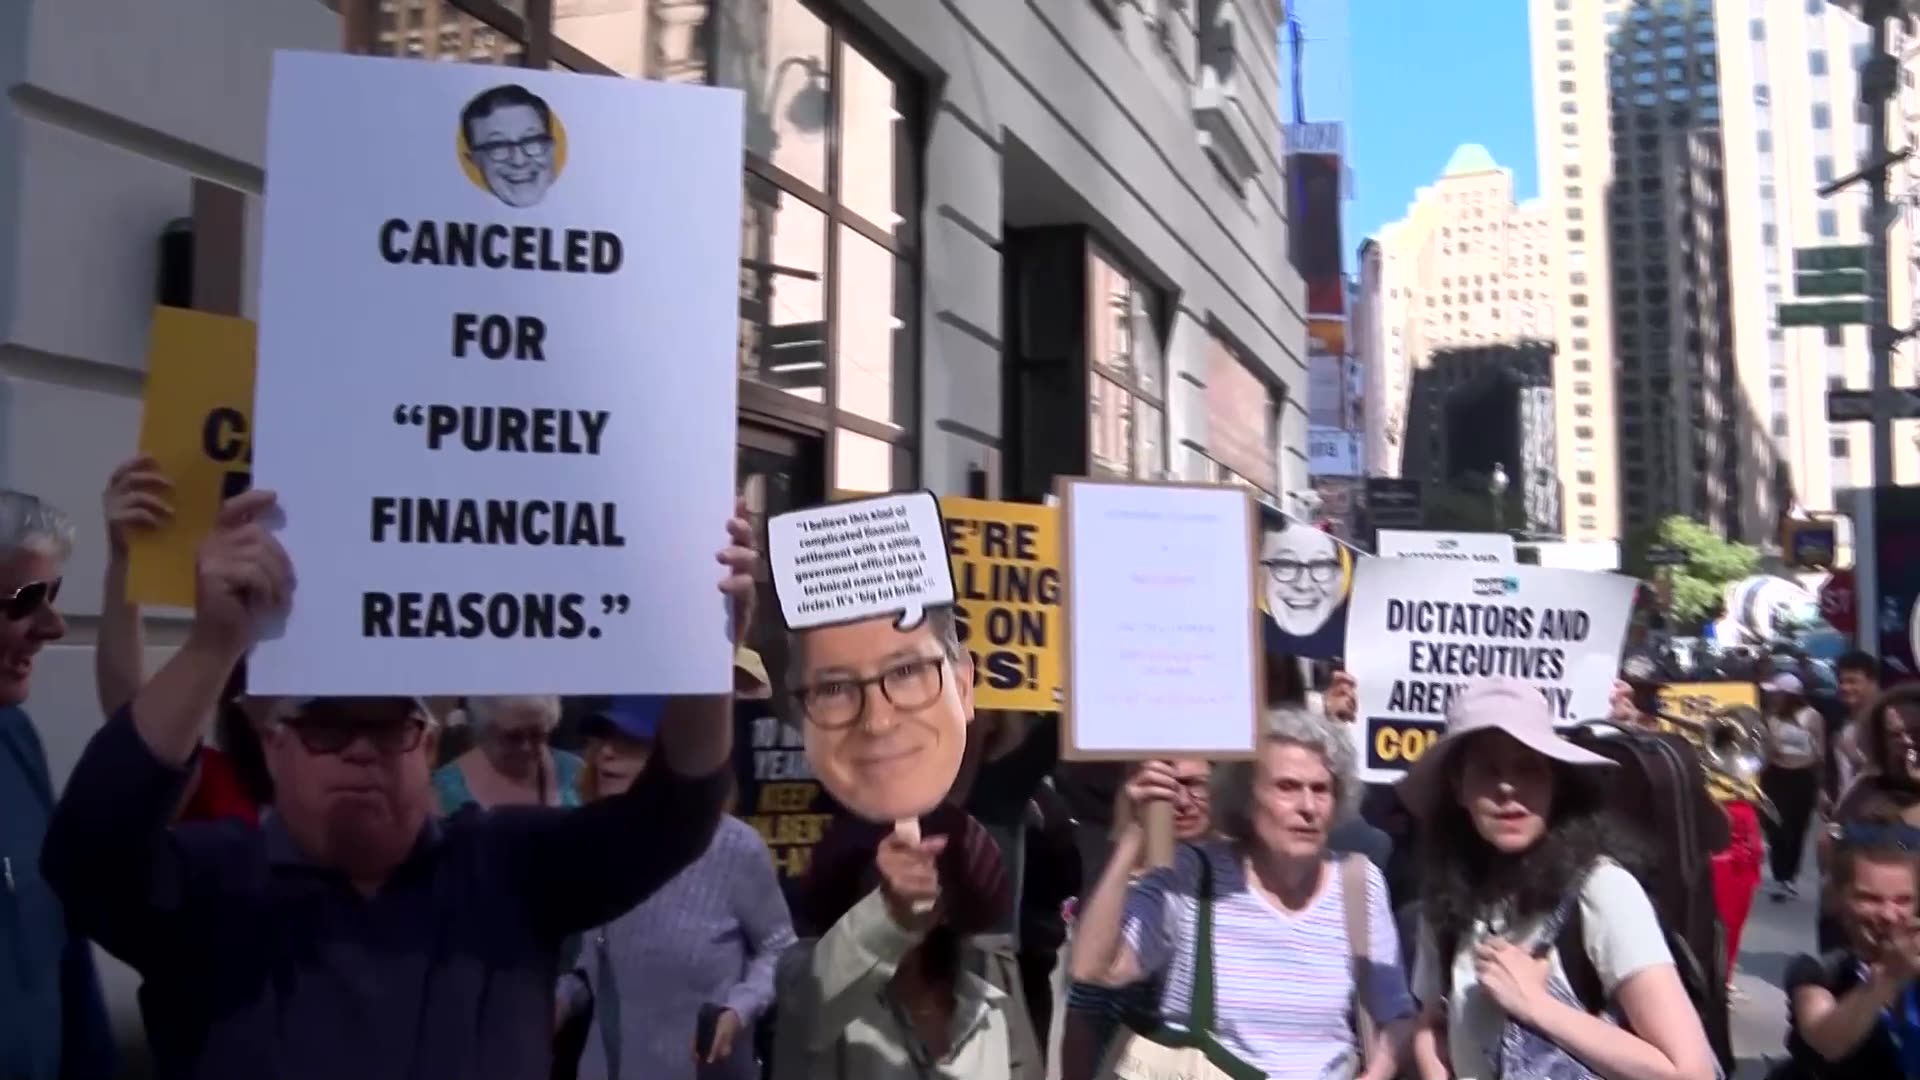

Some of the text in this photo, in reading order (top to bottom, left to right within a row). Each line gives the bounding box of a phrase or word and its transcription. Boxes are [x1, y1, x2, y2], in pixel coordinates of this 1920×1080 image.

[379, 218, 624, 274] CANCELED
[452, 312, 546, 361] FOR
[393, 405, 609, 454] “PURELY
[371, 497, 625, 546] FINANCIAL
[799, 519, 910, 548] complicated financial
[809, 517, 847, 531] believe
[848, 511, 869, 524] this
[870, 506, 894, 521] kind
[947, 517, 1039, 561] E'RE
[794, 535, 921, 565] settlement with a sitting
[794, 550, 927, 585] government official has a
[803, 564, 923, 597] technical name in legal
[877, 587, 893, 601] fat
[957, 563, 1061, 605] LING
[363, 593, 629, 639] REASONS.”
[985, 609, 1047, 648] ON
[1386, 598, 1590, 642] DICTATORS AND
[1409, 640, 1565, 681] EXECUTIVES
